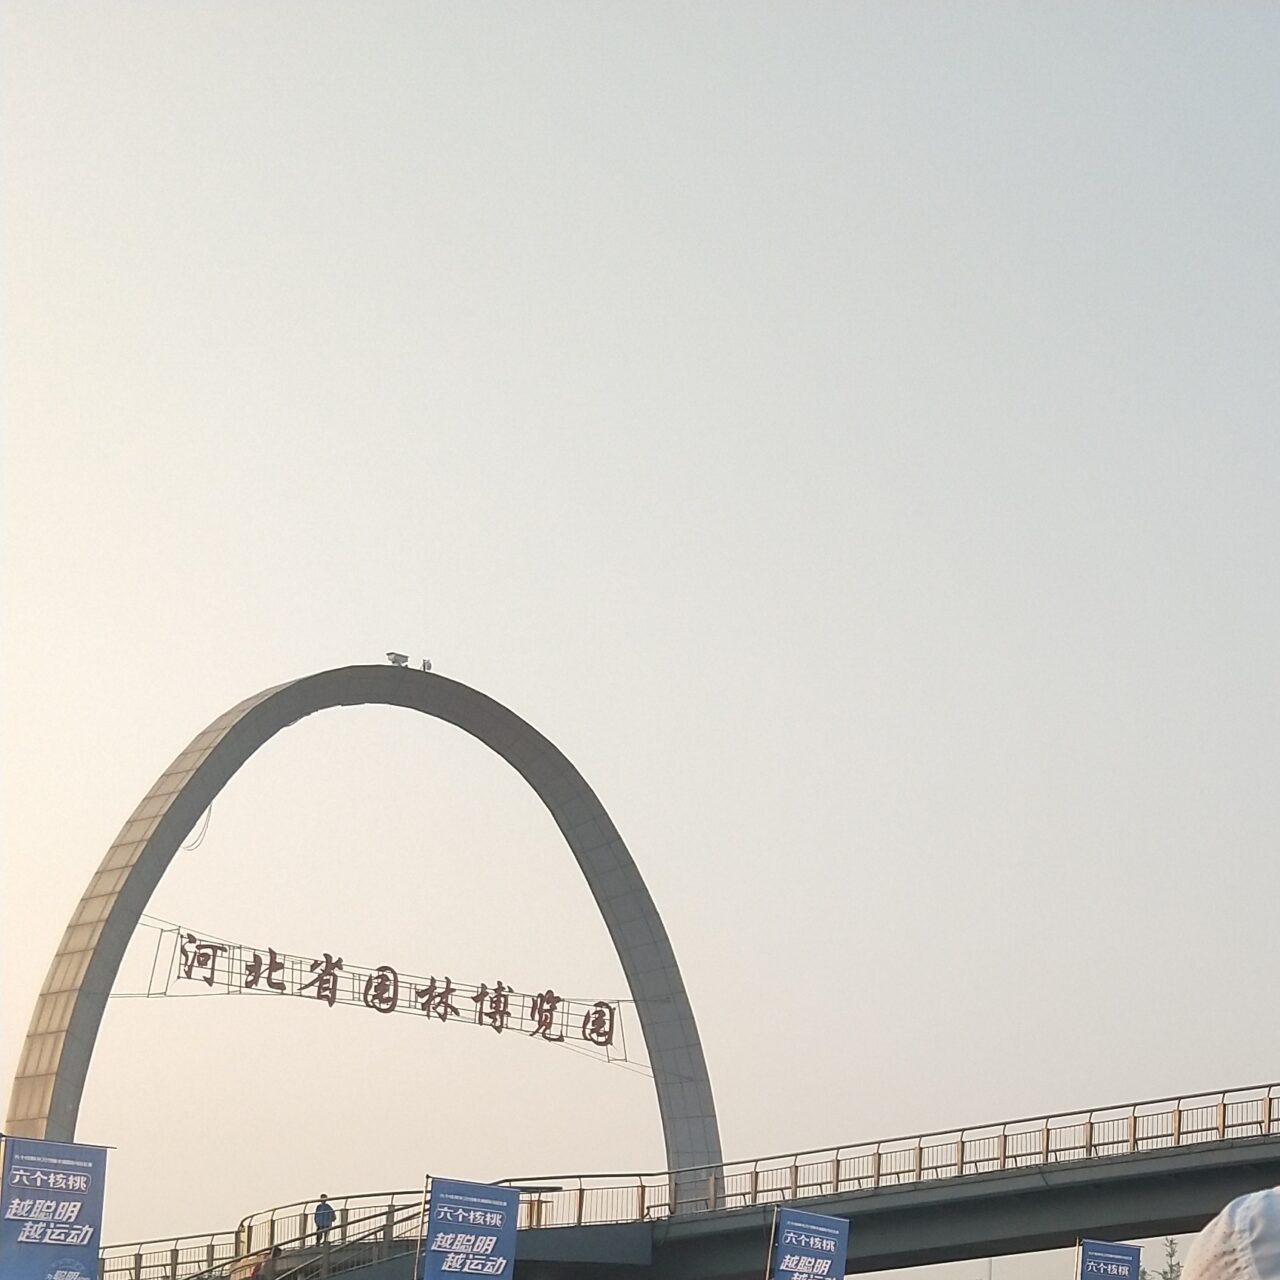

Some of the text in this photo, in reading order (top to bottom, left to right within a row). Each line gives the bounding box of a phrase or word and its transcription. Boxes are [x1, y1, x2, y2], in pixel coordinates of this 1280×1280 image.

[180, 933, 616, 1046] 河北省园林博览园
[12, 1170, 88, 1191] 六个核桃
[5, 1198, 82, 1223] 越聪明
[437, 1207, 503, 1227] 六个核桃
[17, 1221, 94, 1246] 越运动
[431, 1232, 498, 1255] 越聪明
[785, 1232, 836, 1252] 六个核桃
[441, 1253, 508, 1275] 越运动
[780, 1254, 832, 1276] 越聪明
[1086, 1261, 1130, 1277] 六个核桃
